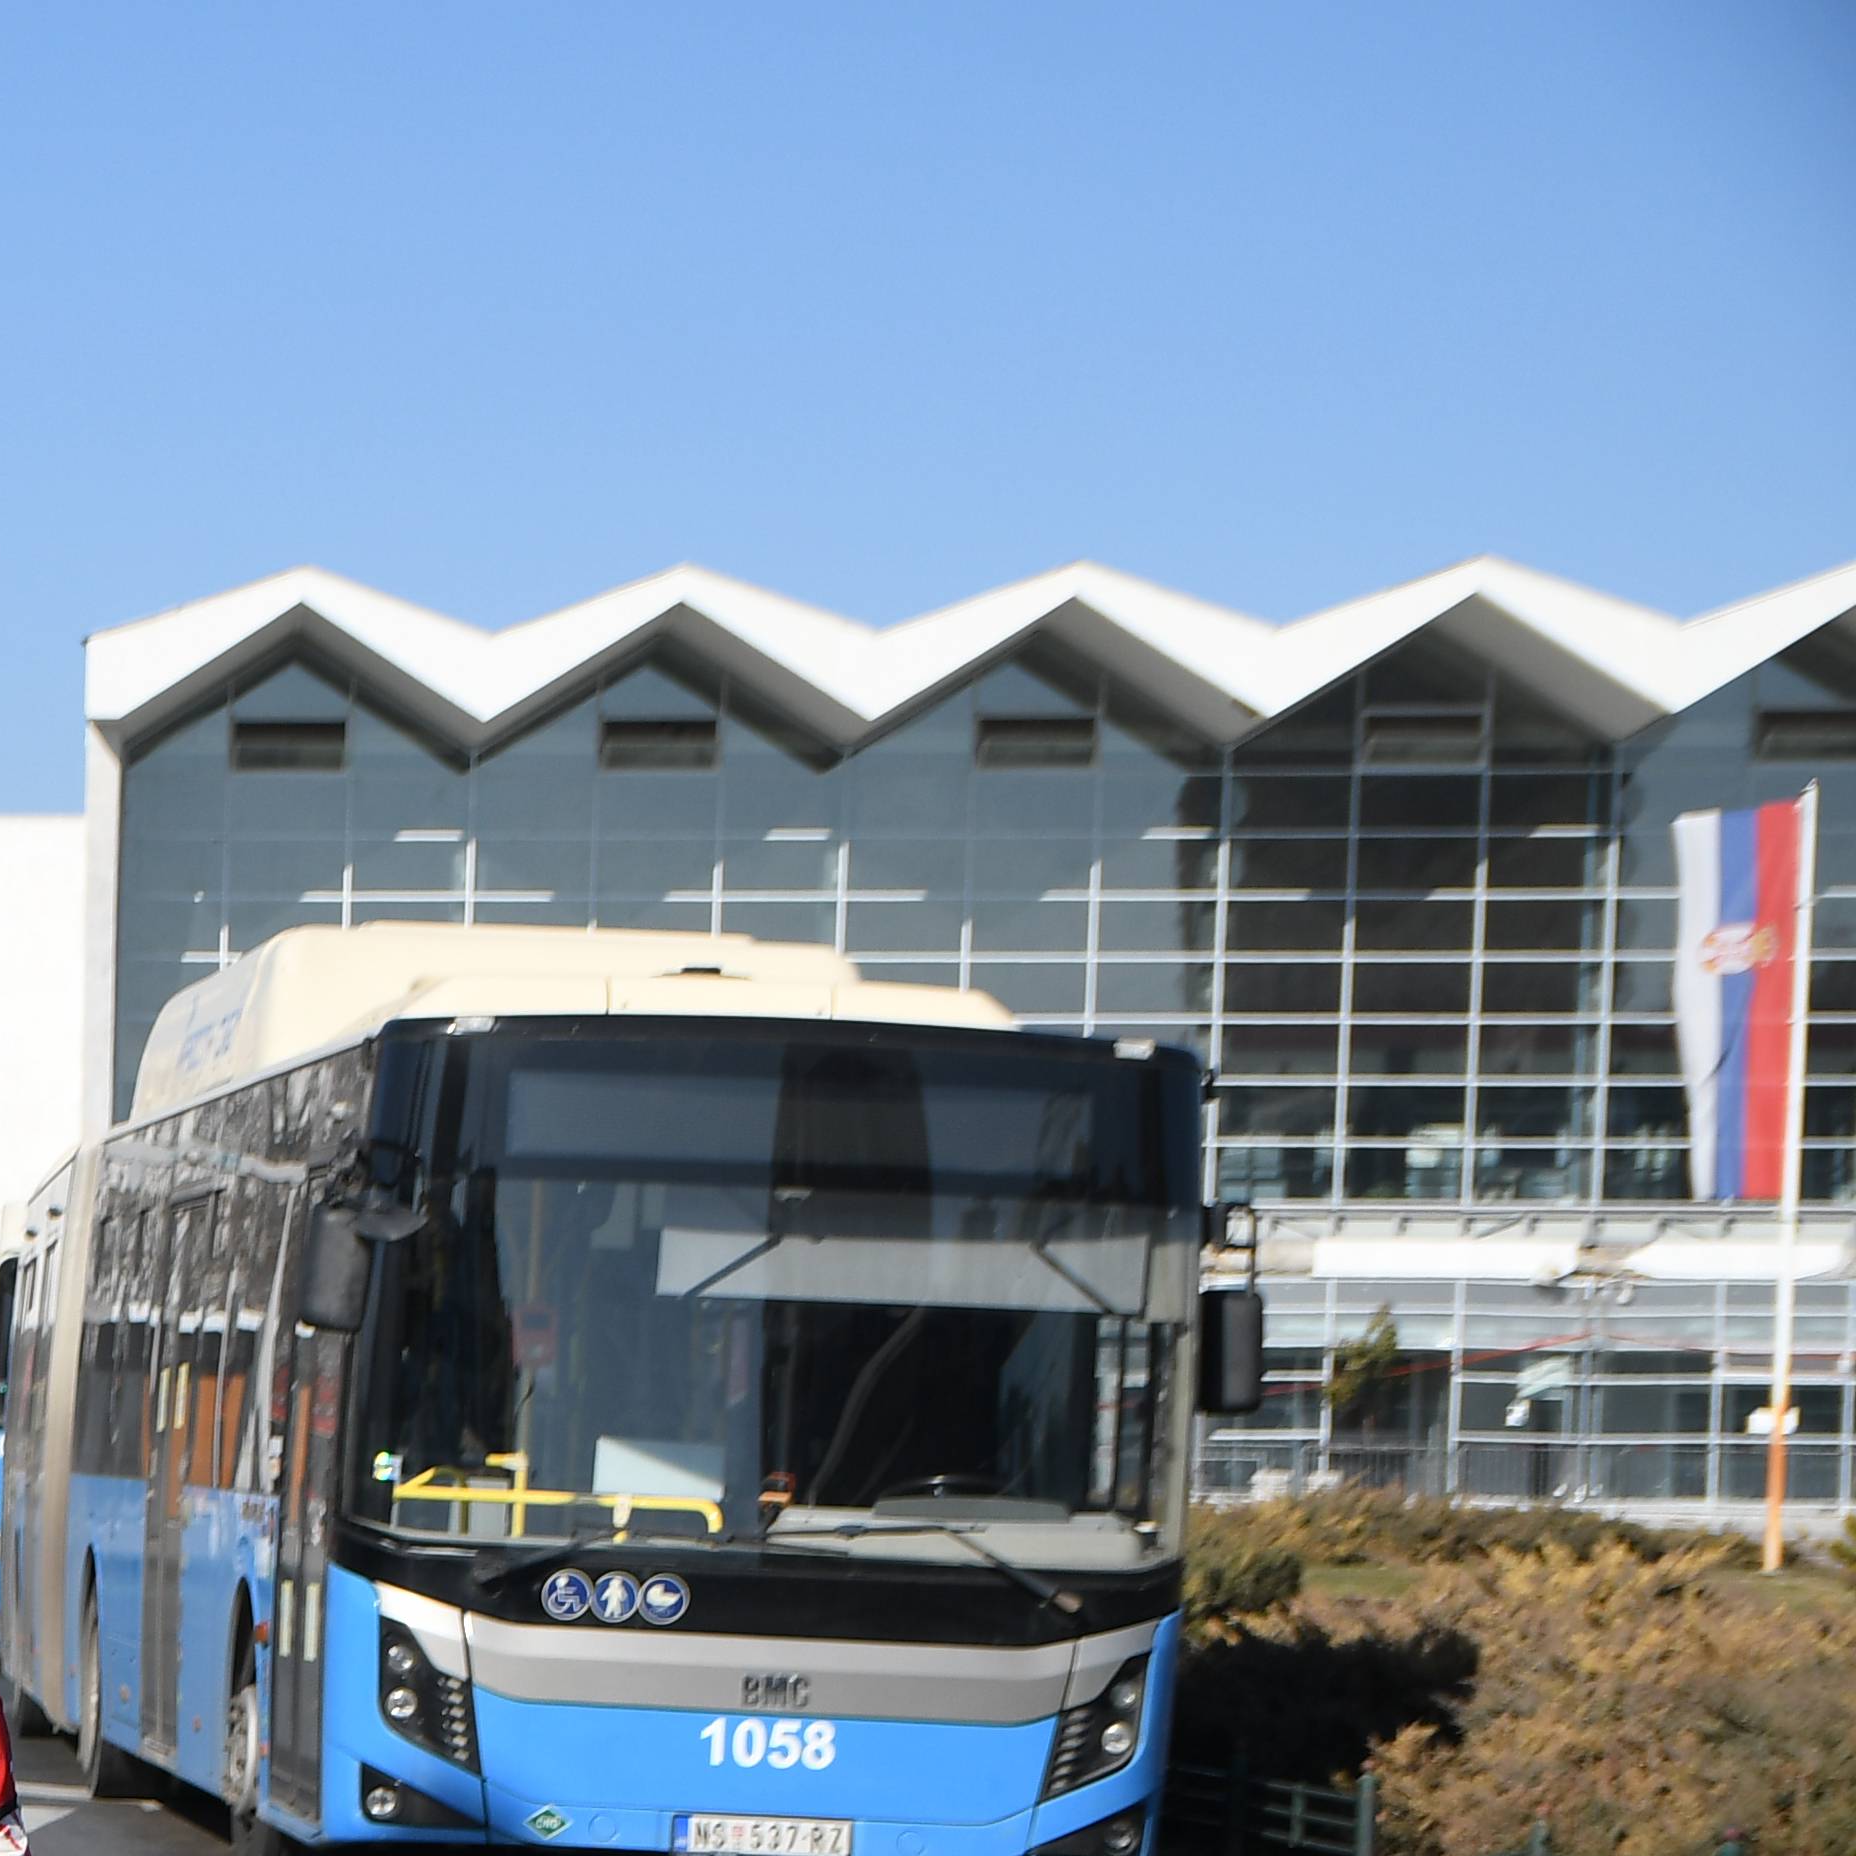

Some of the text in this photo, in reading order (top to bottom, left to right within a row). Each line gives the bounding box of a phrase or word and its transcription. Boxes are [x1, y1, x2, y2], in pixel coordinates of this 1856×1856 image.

[742, 1673, 810, 1708] BMC
[699, 1717, 837, 1770] 1058
[694, 1822, 726, 1849] NS
